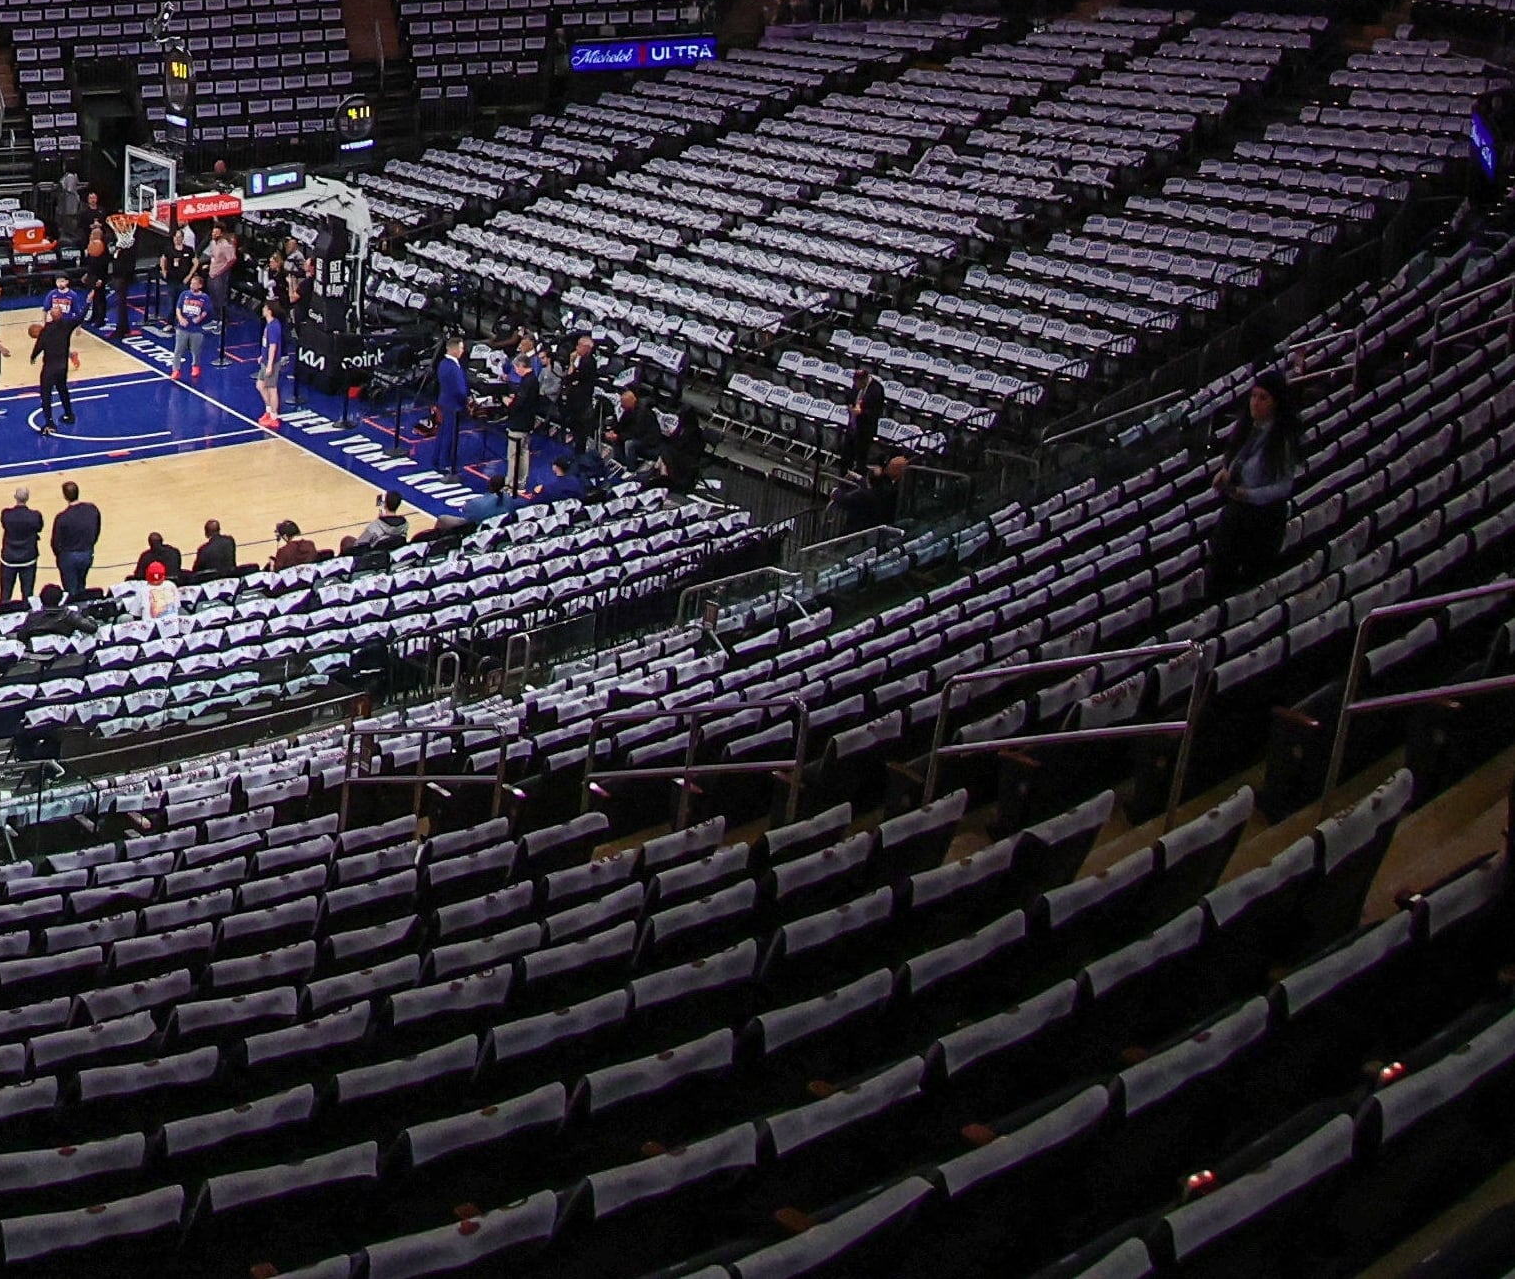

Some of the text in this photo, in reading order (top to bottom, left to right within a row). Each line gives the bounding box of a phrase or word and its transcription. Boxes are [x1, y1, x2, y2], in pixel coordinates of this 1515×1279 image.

[571, 42, 714, 68] Michelob ULTRA
[329, 261, 342, 273] GET
[279, 409, 347, 435] NEW
[328, 434, 419, 472] YORK
